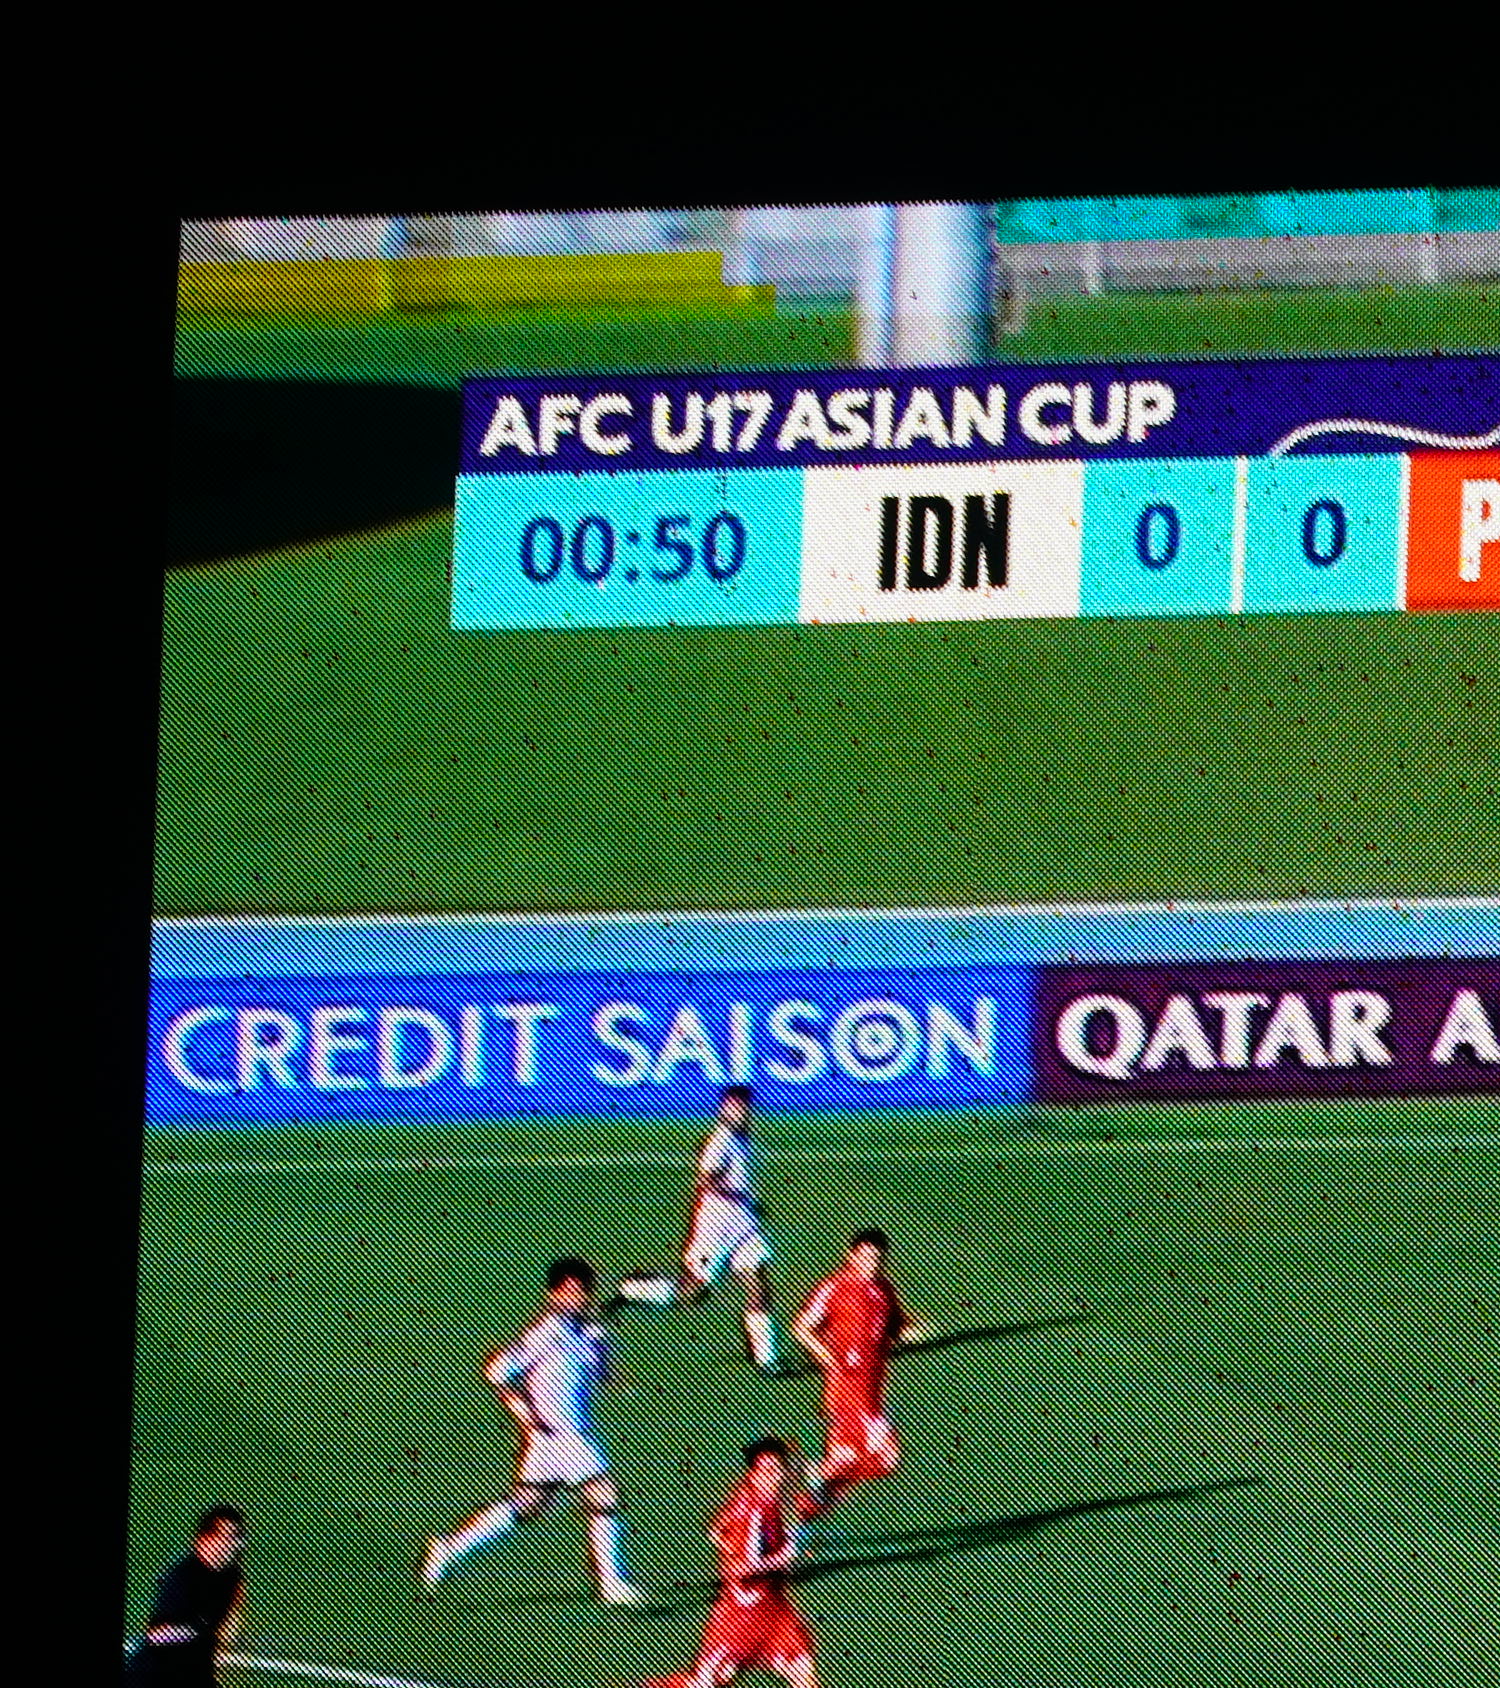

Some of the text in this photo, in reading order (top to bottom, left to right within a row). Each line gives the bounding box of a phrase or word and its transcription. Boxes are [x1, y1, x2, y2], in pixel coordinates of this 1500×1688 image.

[480, 380, 1178, 458] AFC U17 ASIAN CUP
[517, 513, 748, 582] 00:50
[877, 492, 1012, 590] IDN
[1134, 500, 1182, 570] 0
[1300, 497, 1349, 569] 0
[160, 997, 998, 1093] CREDIT SAISON
[1055, 990, 1392, 1082] QATAR
